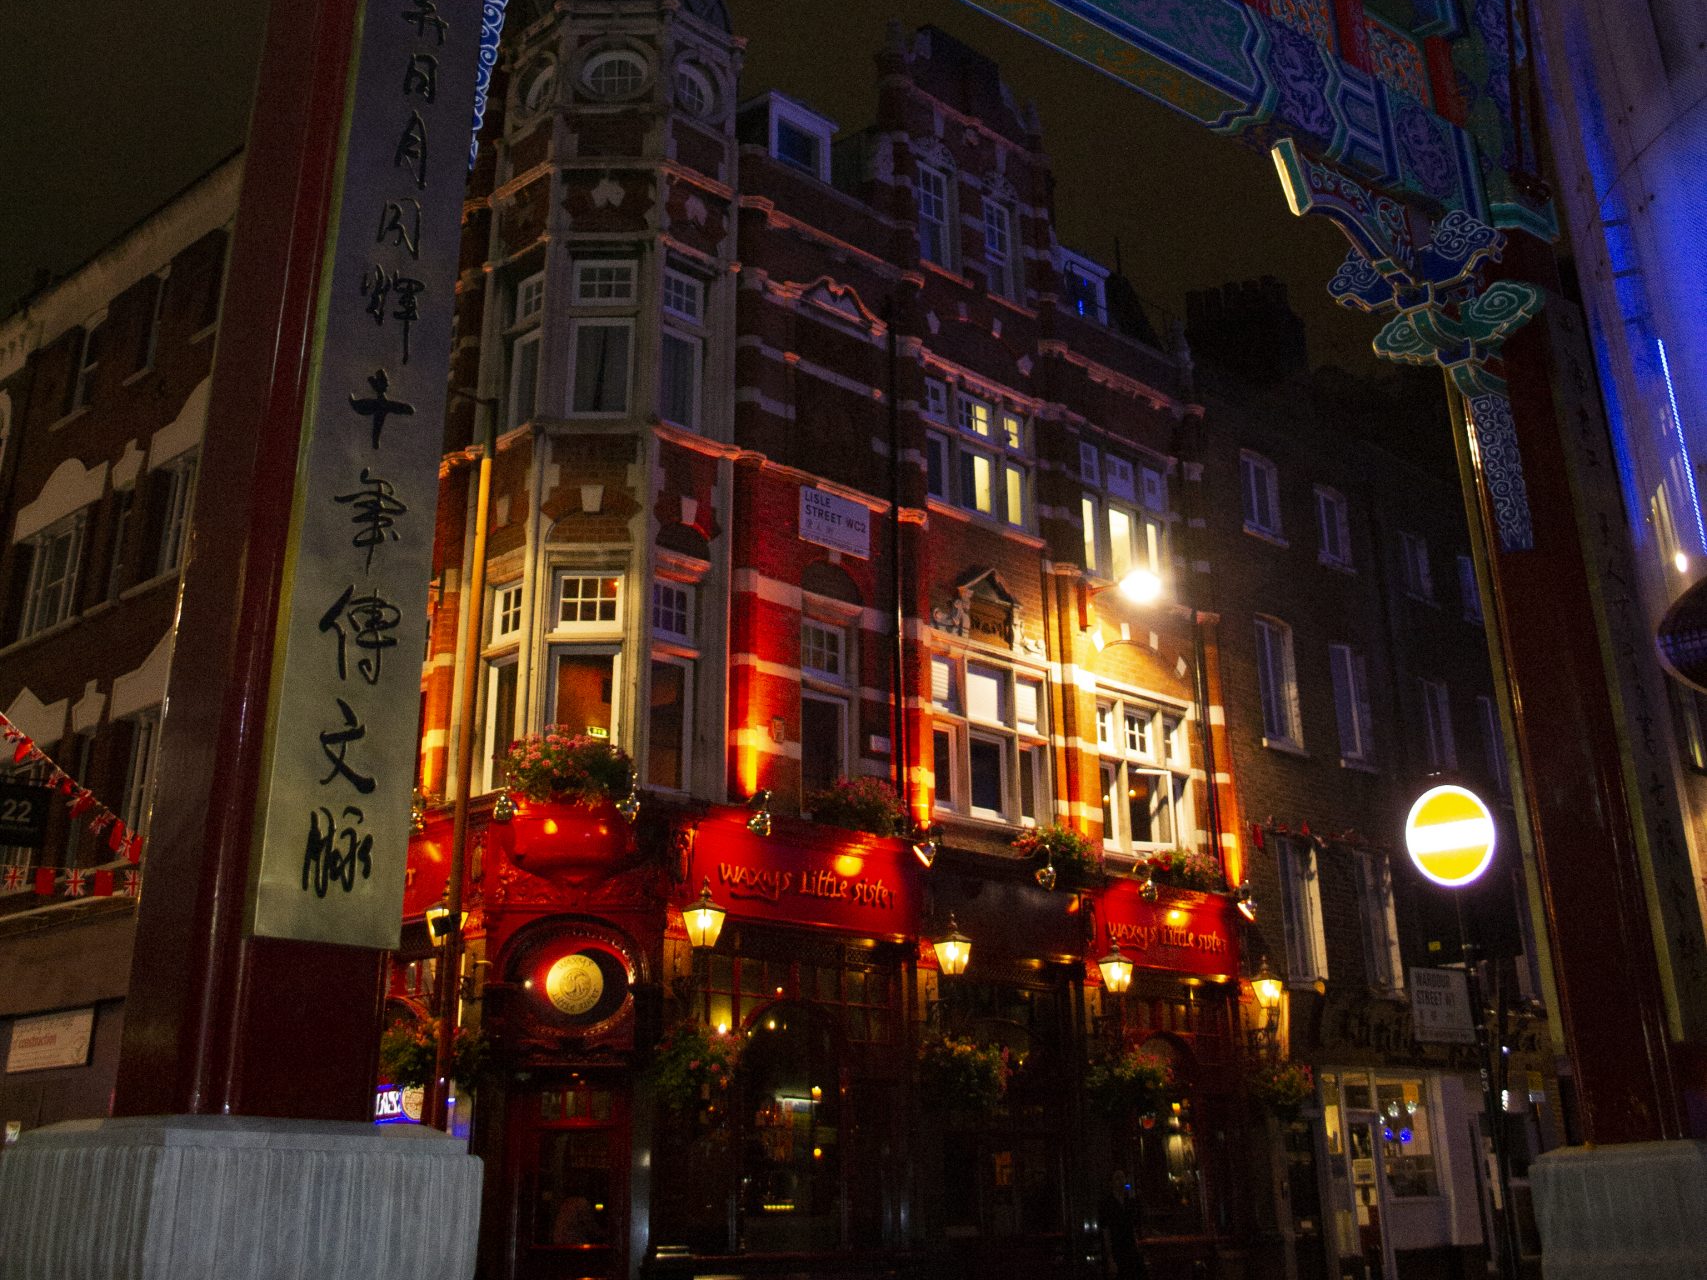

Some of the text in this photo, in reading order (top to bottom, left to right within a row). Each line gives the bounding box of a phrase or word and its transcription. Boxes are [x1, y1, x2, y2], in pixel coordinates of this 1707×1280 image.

[804, 490, 831, 508] LISLE
[805, 504, 842, 526] STREET
[845, 517, 867, 534] WC2
[1, 798, 32, 823] 22
